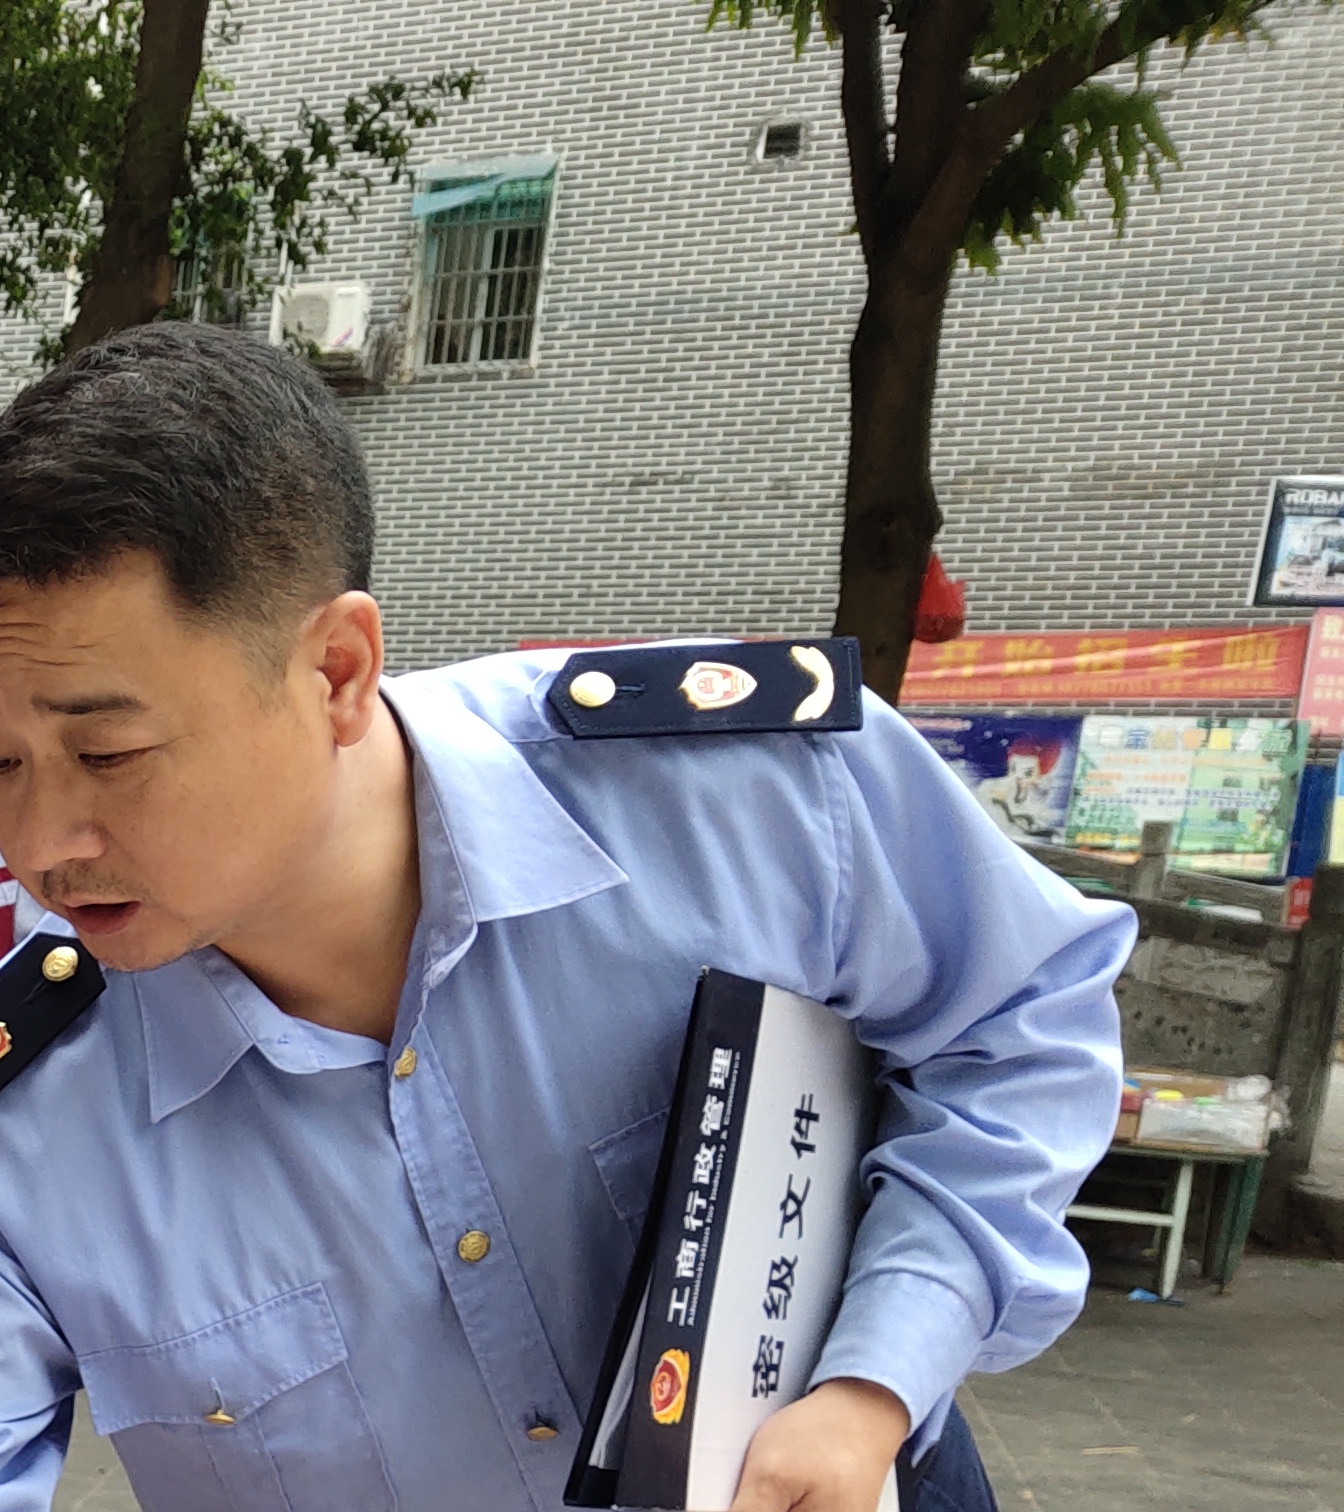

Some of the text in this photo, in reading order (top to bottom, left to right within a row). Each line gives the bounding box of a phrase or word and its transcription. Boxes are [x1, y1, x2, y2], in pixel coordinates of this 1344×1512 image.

[1283, 488, 1344, 506] ROBA
[667, 1046, 733, 1327] 工商行政管理
[751, 1093, 821, 1398] 密级文件
